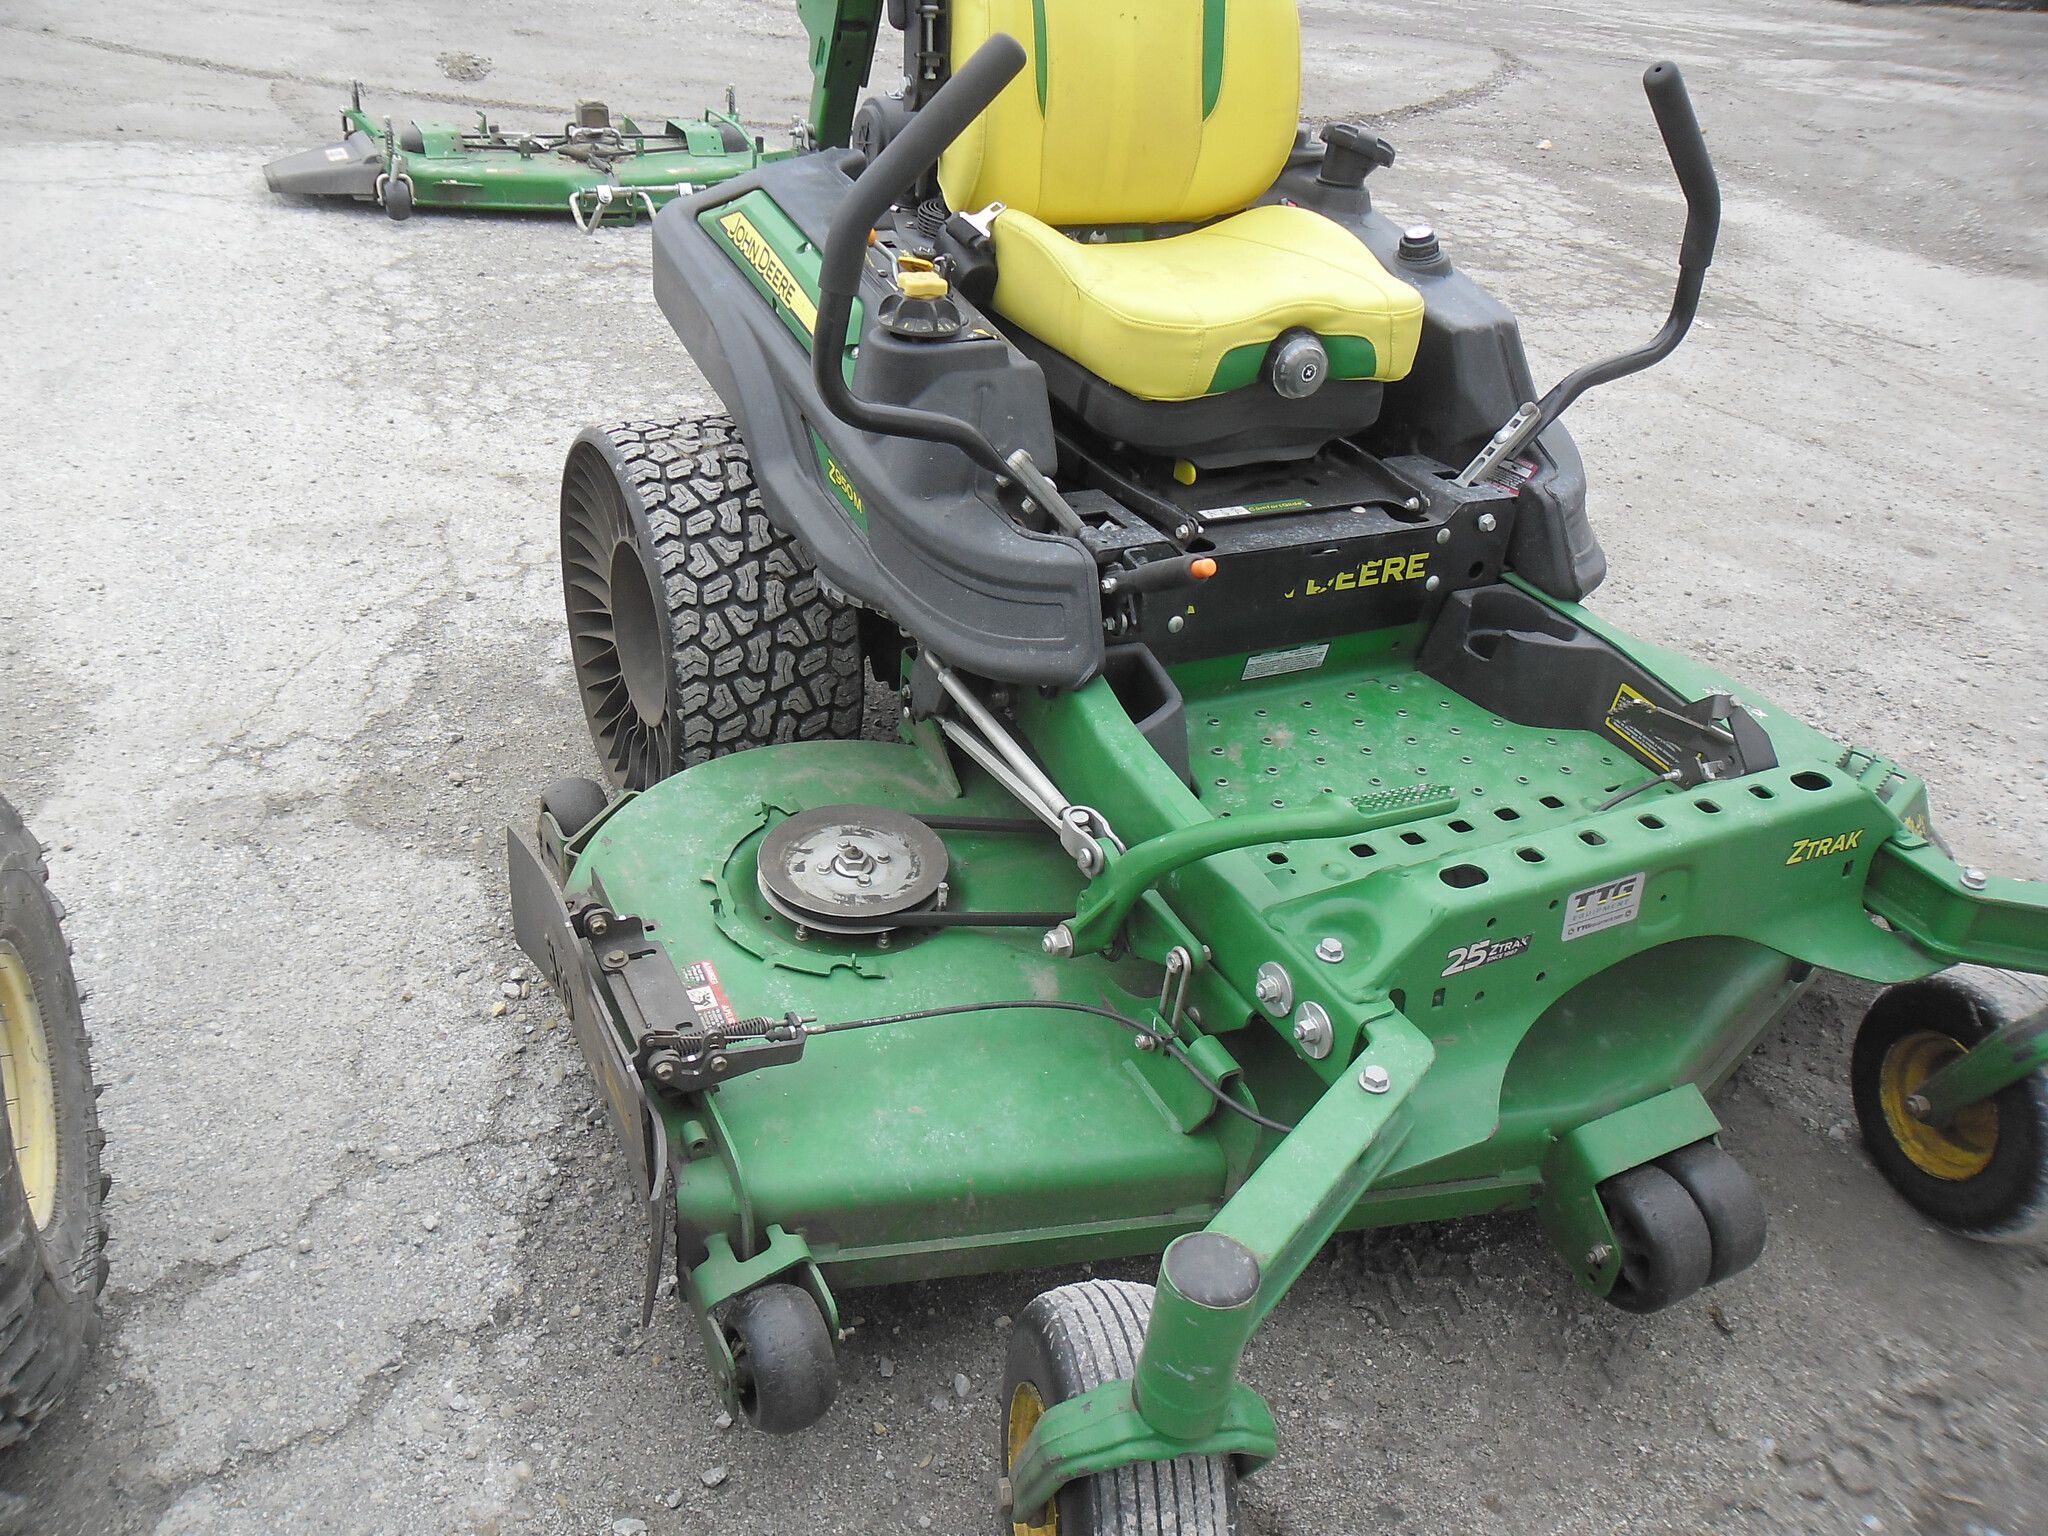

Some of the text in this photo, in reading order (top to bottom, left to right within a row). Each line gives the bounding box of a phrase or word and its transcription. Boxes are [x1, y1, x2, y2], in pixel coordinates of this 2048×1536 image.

[729, 217, 796, 306] JOHN DEERE
[827, 458, 862, 514] Z950M
[1785, 829, 1864, 865] ZTRAK
[1572, 899, 1629, 920] EQUIPMENT
[1575, 877, 1637, 911] TTG
[1441, 936, 1529, 977] 25 ZTRAK
